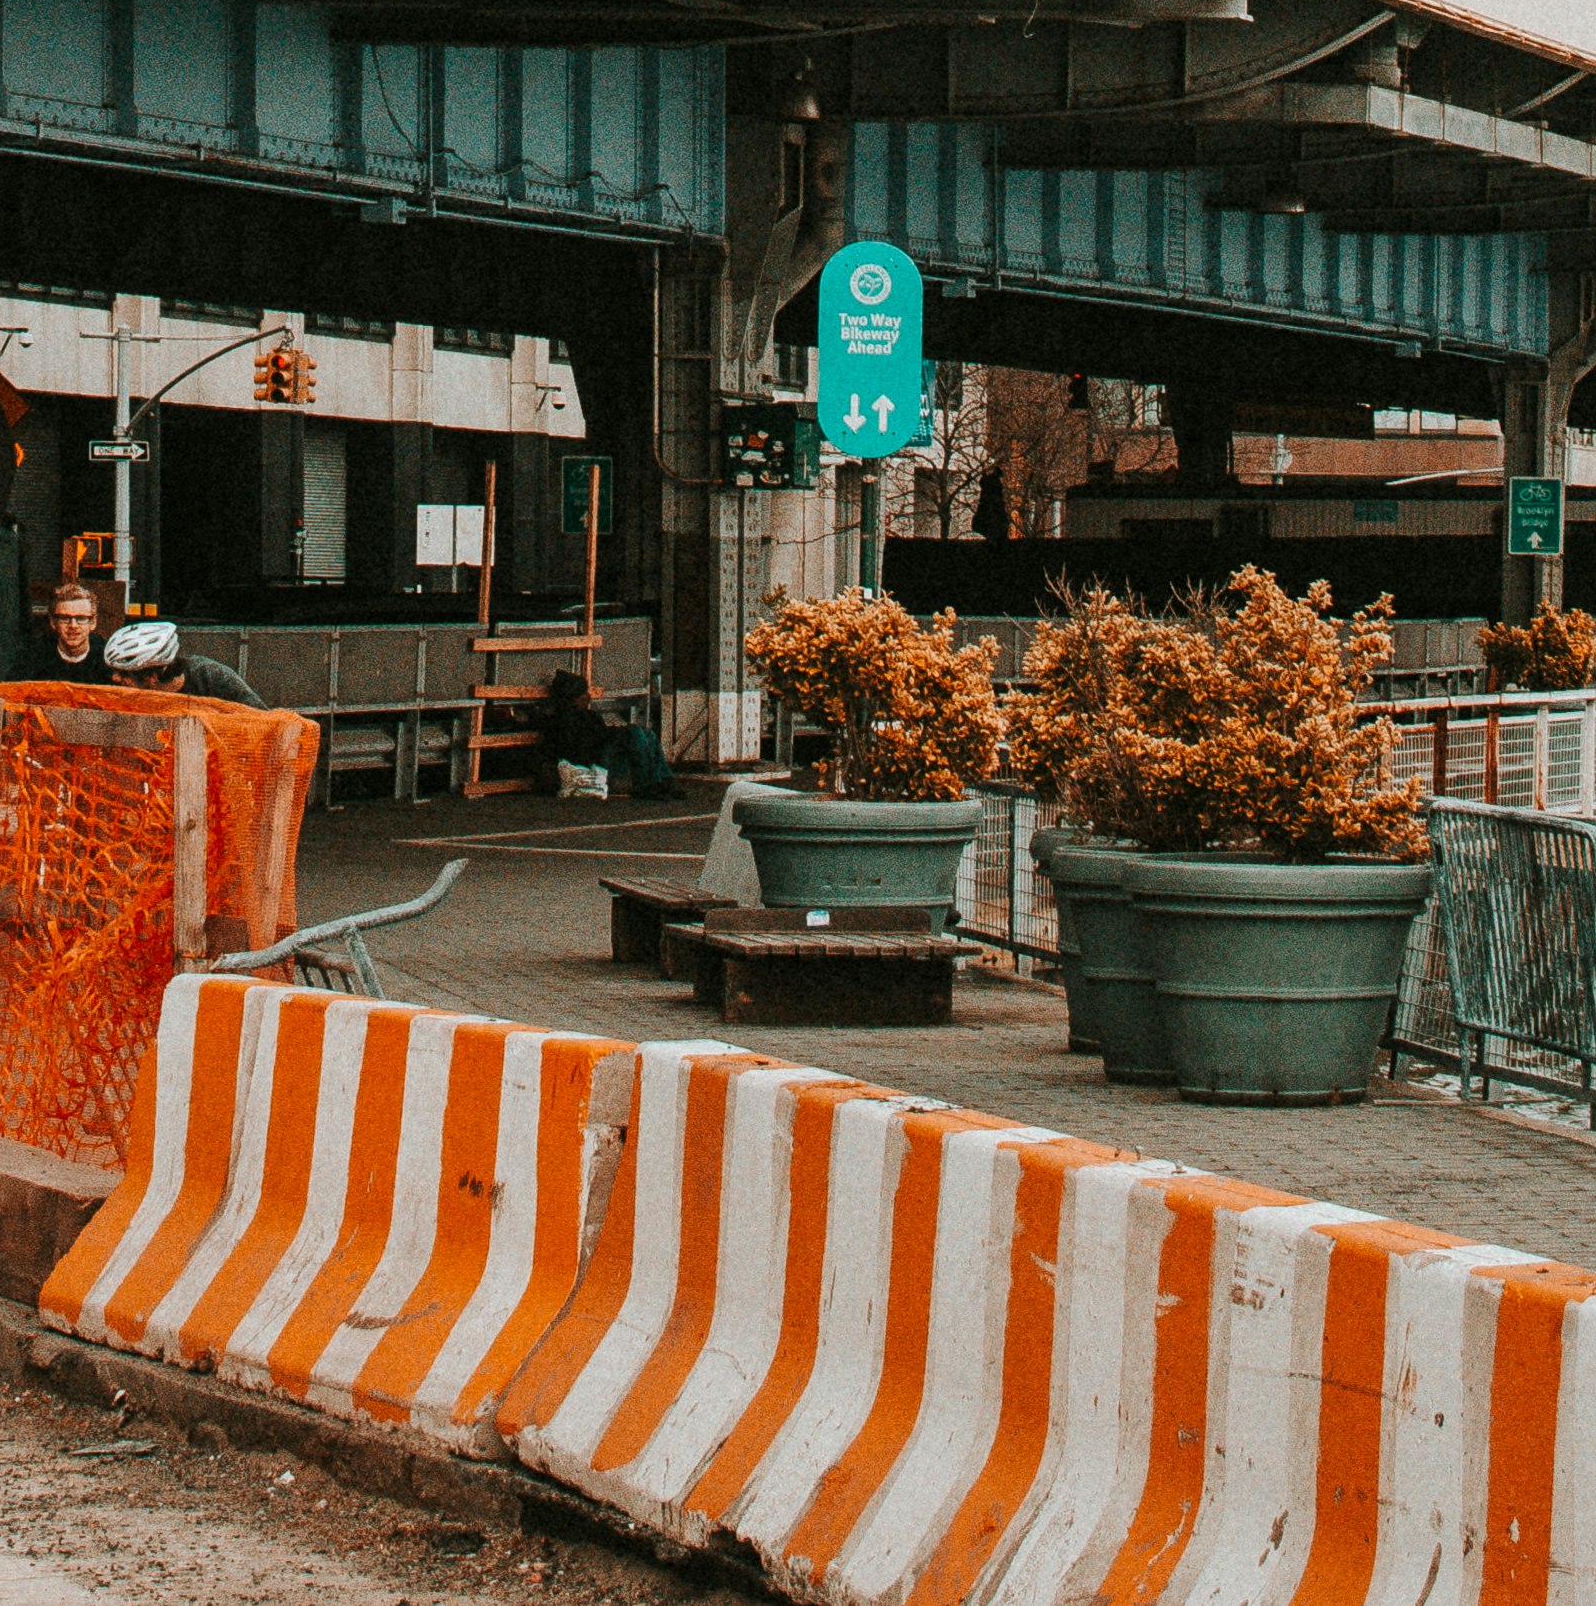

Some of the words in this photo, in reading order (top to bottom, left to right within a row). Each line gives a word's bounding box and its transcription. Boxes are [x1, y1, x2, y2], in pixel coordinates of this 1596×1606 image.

[838, 312, 868, 327] Two
[870, 312, 902, 330] Way
[840, 326, 900, 344] Bikeway
[847, 340, 892, 356] Ahead
